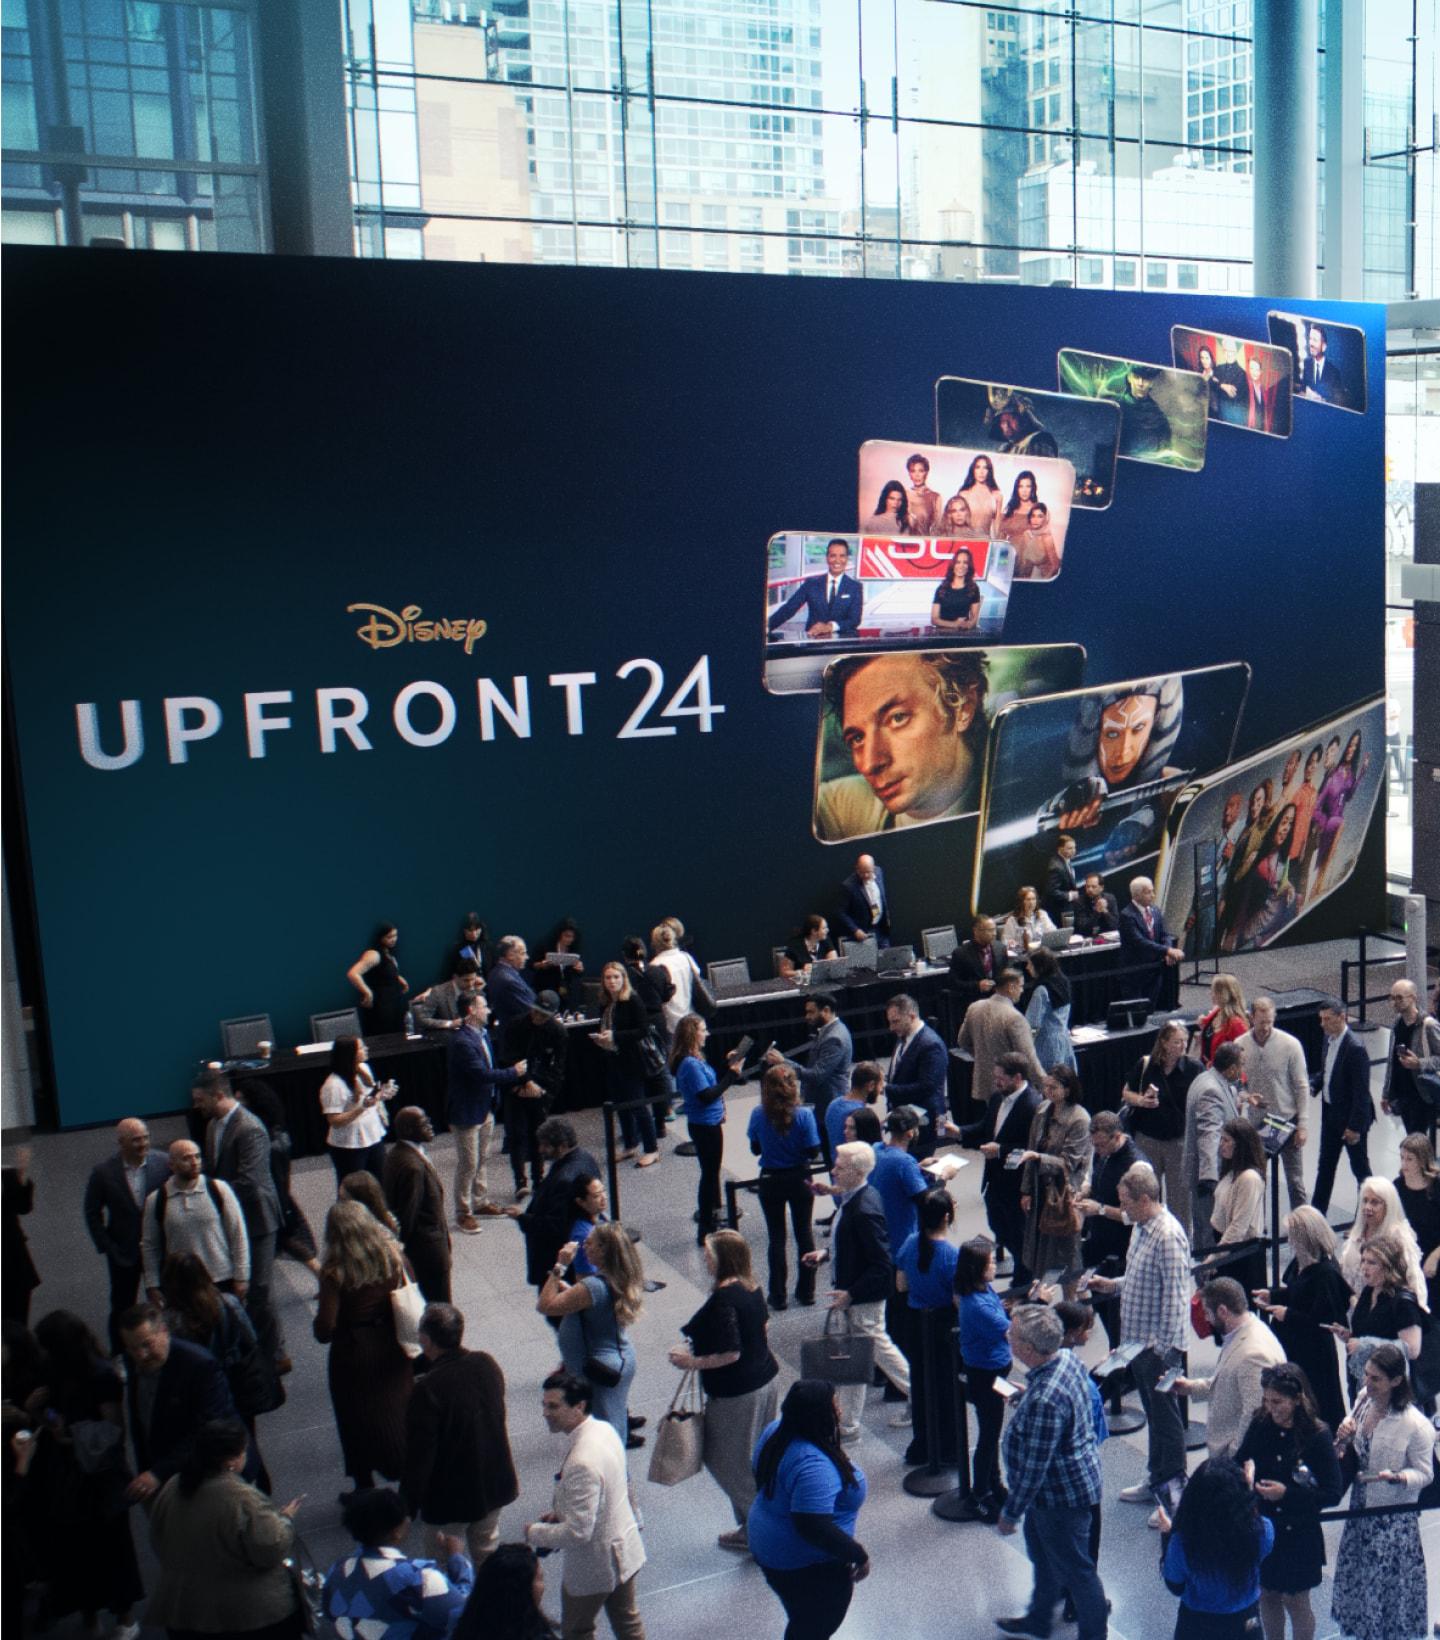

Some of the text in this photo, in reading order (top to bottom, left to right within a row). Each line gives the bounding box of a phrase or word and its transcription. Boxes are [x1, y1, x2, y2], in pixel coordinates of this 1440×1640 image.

[346, 602, 487, 655] Disney
[75, 654, 726, 771] UPFRONT 24
